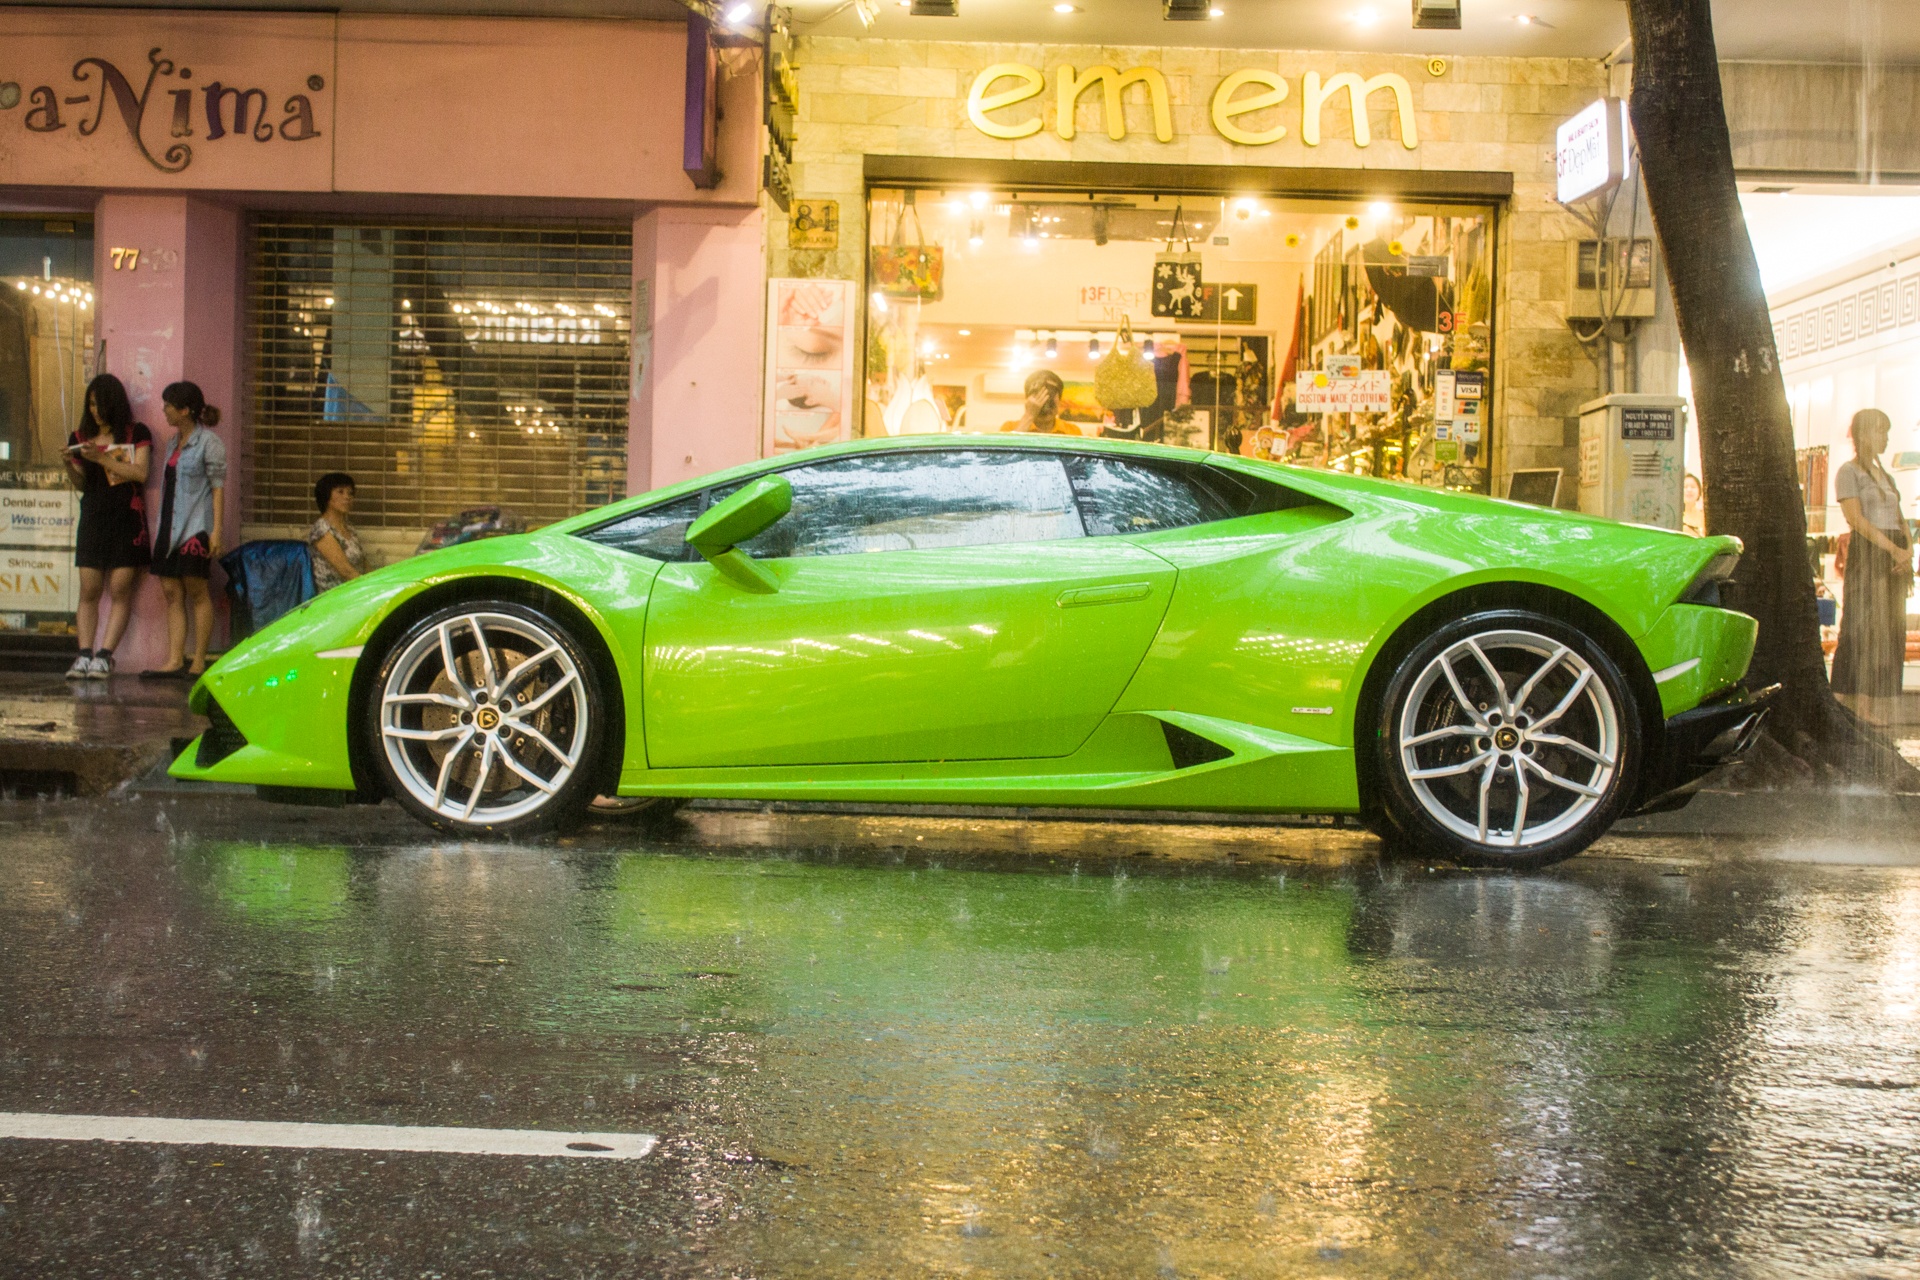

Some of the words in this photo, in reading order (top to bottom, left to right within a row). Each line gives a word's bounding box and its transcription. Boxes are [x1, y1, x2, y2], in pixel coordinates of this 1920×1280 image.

[967, 62, 1173, 144] em
[1211, 67, 1418, 150] em
[1438, 311, 1467, 332] 3F
[1306, 380, 1380, 392] オダーメイド
[1460, 386, 1478, 394] VISA
[1298, 393, 1326, 404] CUSTOM
[1330, 393, 1348, 404] MADE
[1351, 393, 1388, 404] CLOTHING
[16, 472, 42, 482] VISIT
[44, 472, 59, 482] US
[3, 497, 36, 508] Dental
[39, 500, 62, 509] care
[12, 513, 74, 526] Westcoast
[8, 558, 54, 569] Skincare
